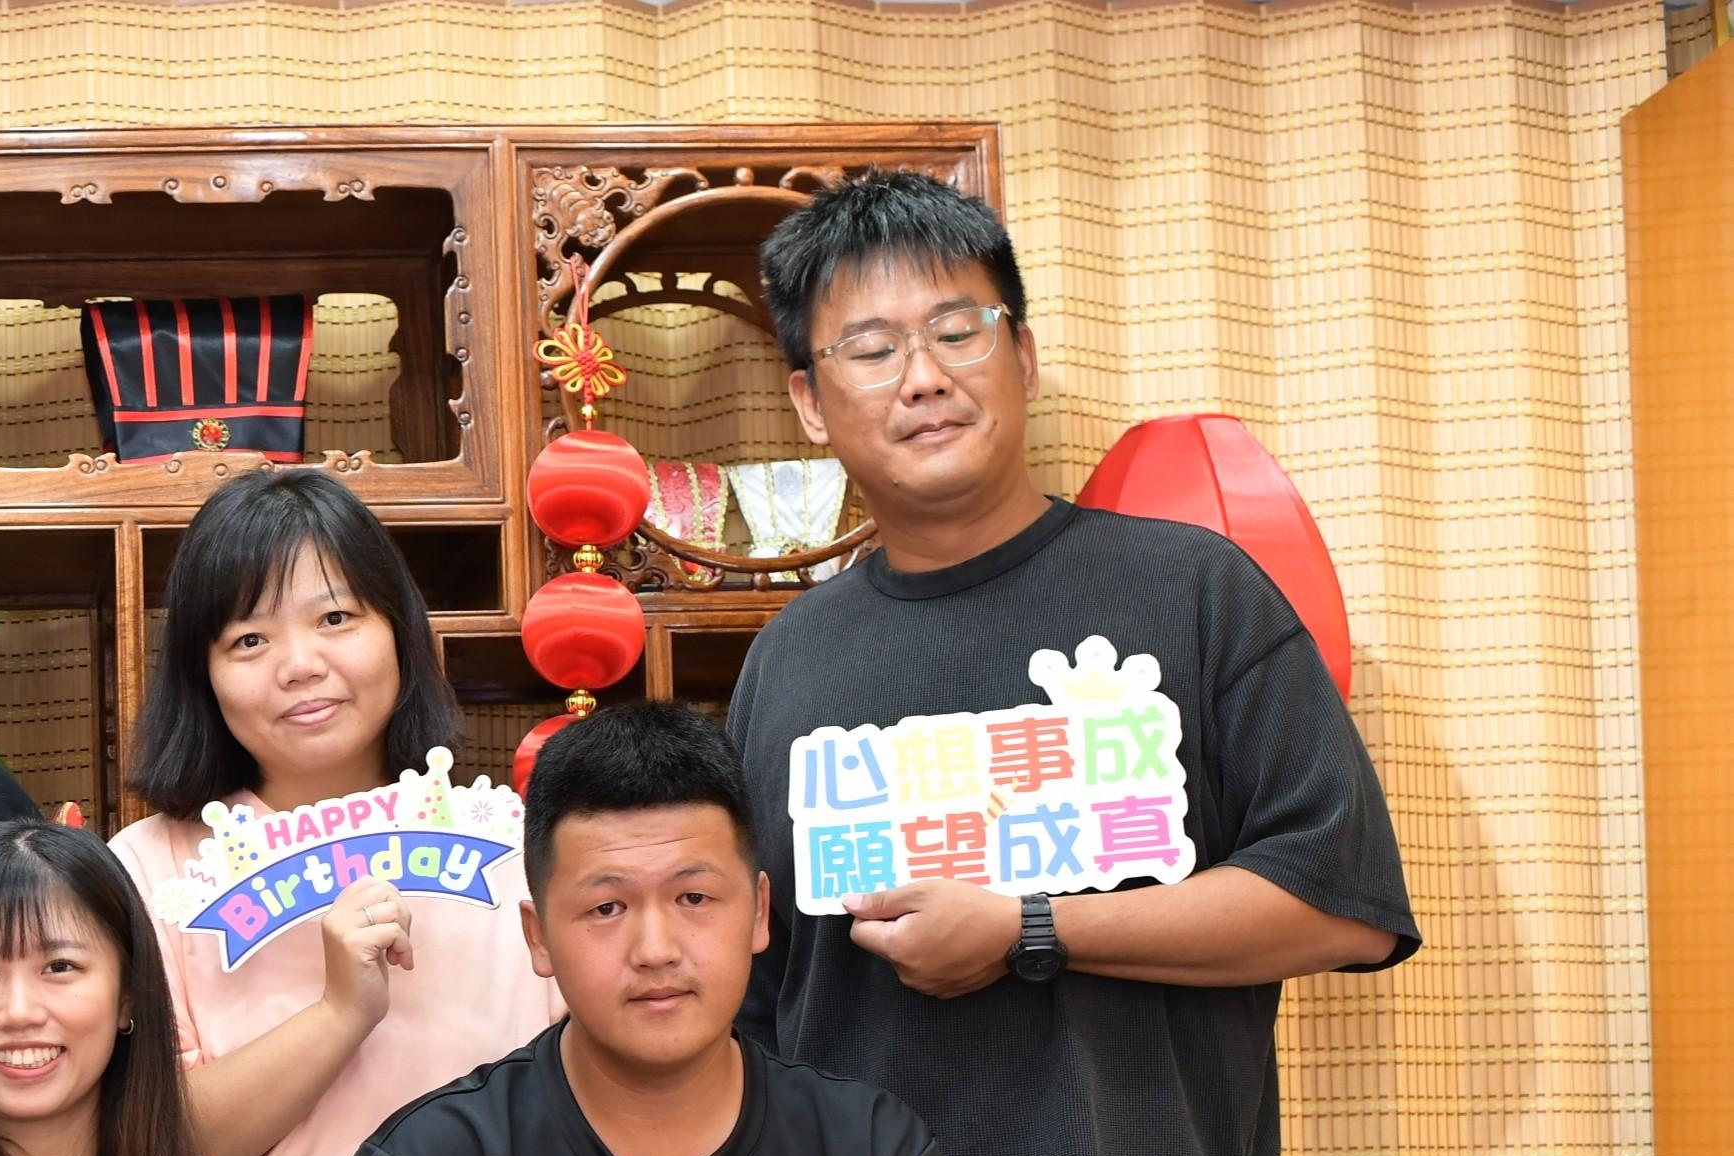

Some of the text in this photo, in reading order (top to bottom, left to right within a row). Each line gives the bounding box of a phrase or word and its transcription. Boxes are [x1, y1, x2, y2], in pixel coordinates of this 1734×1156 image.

[803, 705, 1170, 811] 心想事成
[265, 791, 399, 849] HAPPY
[808, 796, 1181, 900] 願望成真
[218, 835, 482, 941] Birthday
